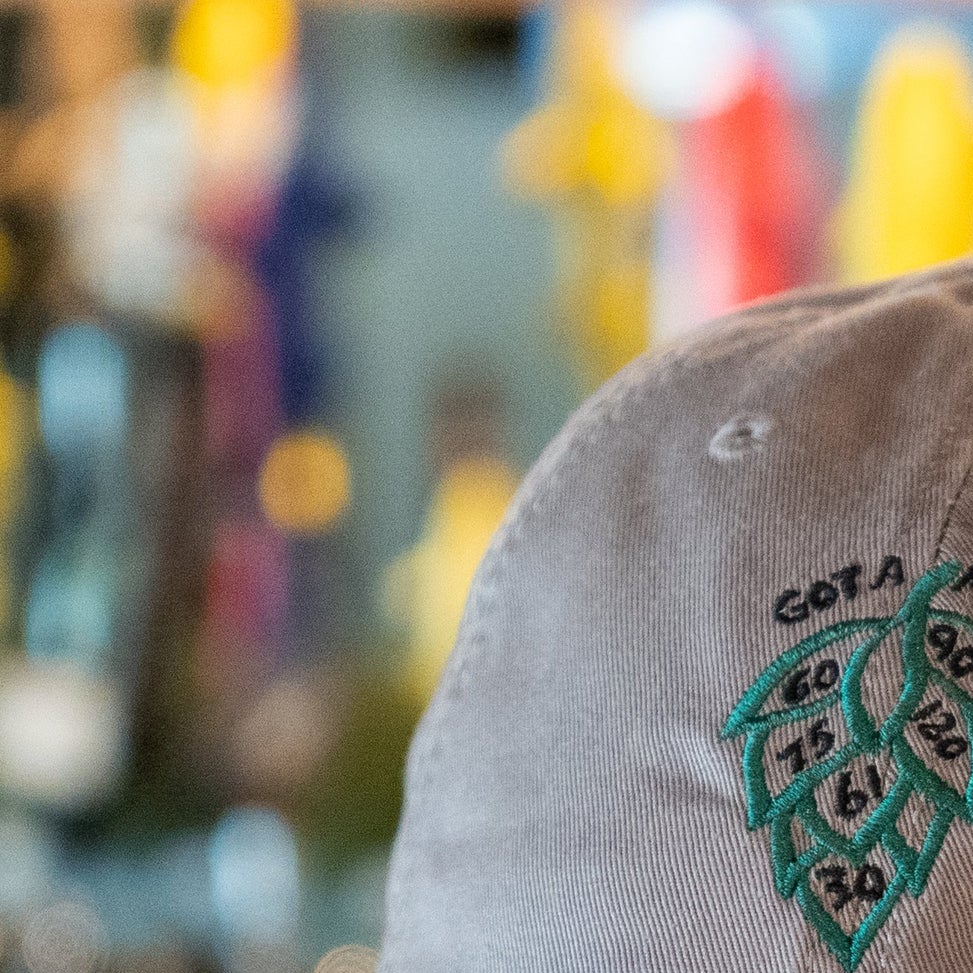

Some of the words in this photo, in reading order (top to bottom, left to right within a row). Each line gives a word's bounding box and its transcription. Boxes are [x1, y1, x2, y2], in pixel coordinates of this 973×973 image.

[772, 564, 862, 624] GOT
[870, 555, 905, 589] A
[782, 658, 839, 704] 60
[776, 718, 835, 775] 75
[910, 700, 968, 761] 120
[835, 765, 882, 820] 61
[815, 864, 886, 910] 30
